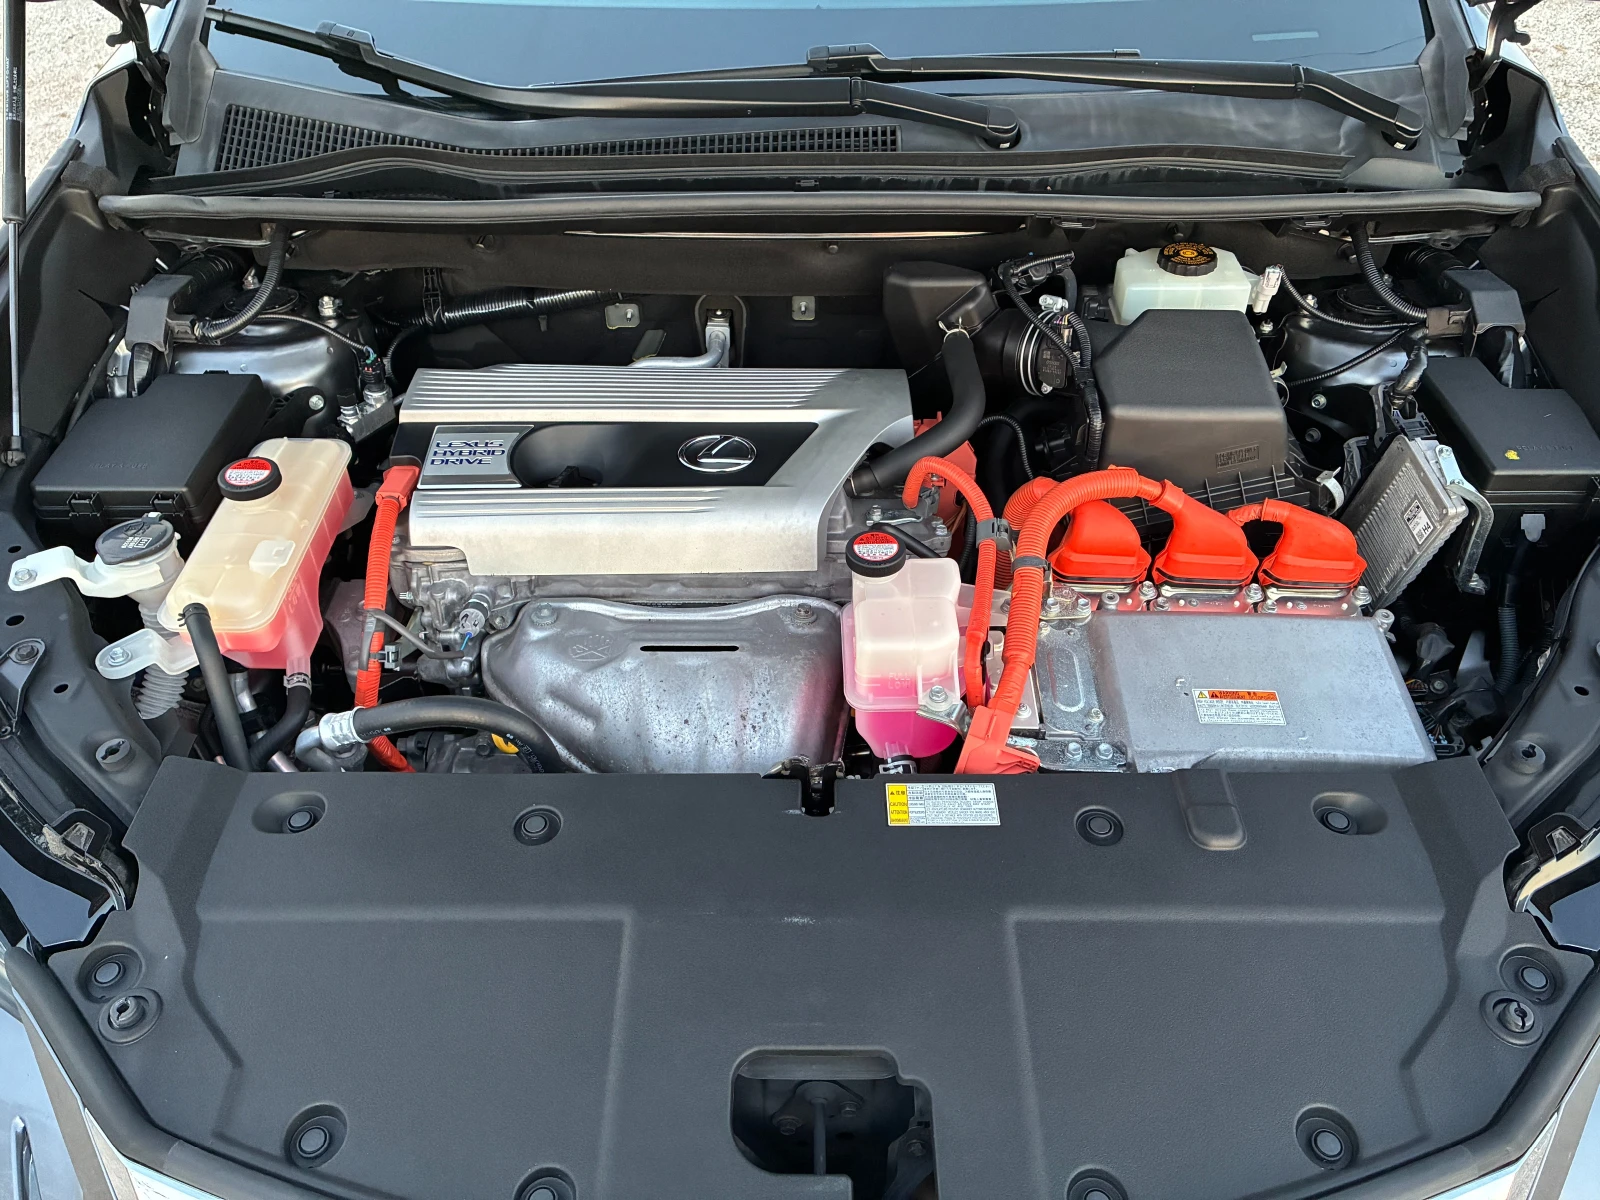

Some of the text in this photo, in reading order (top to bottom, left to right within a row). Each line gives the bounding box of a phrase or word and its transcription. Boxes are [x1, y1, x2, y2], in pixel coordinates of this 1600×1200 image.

[435, 440, 504, 448] LEXUS
[432, 448, 506, 457] HYBRID
[430, 457, 493, 466] DRIVE
